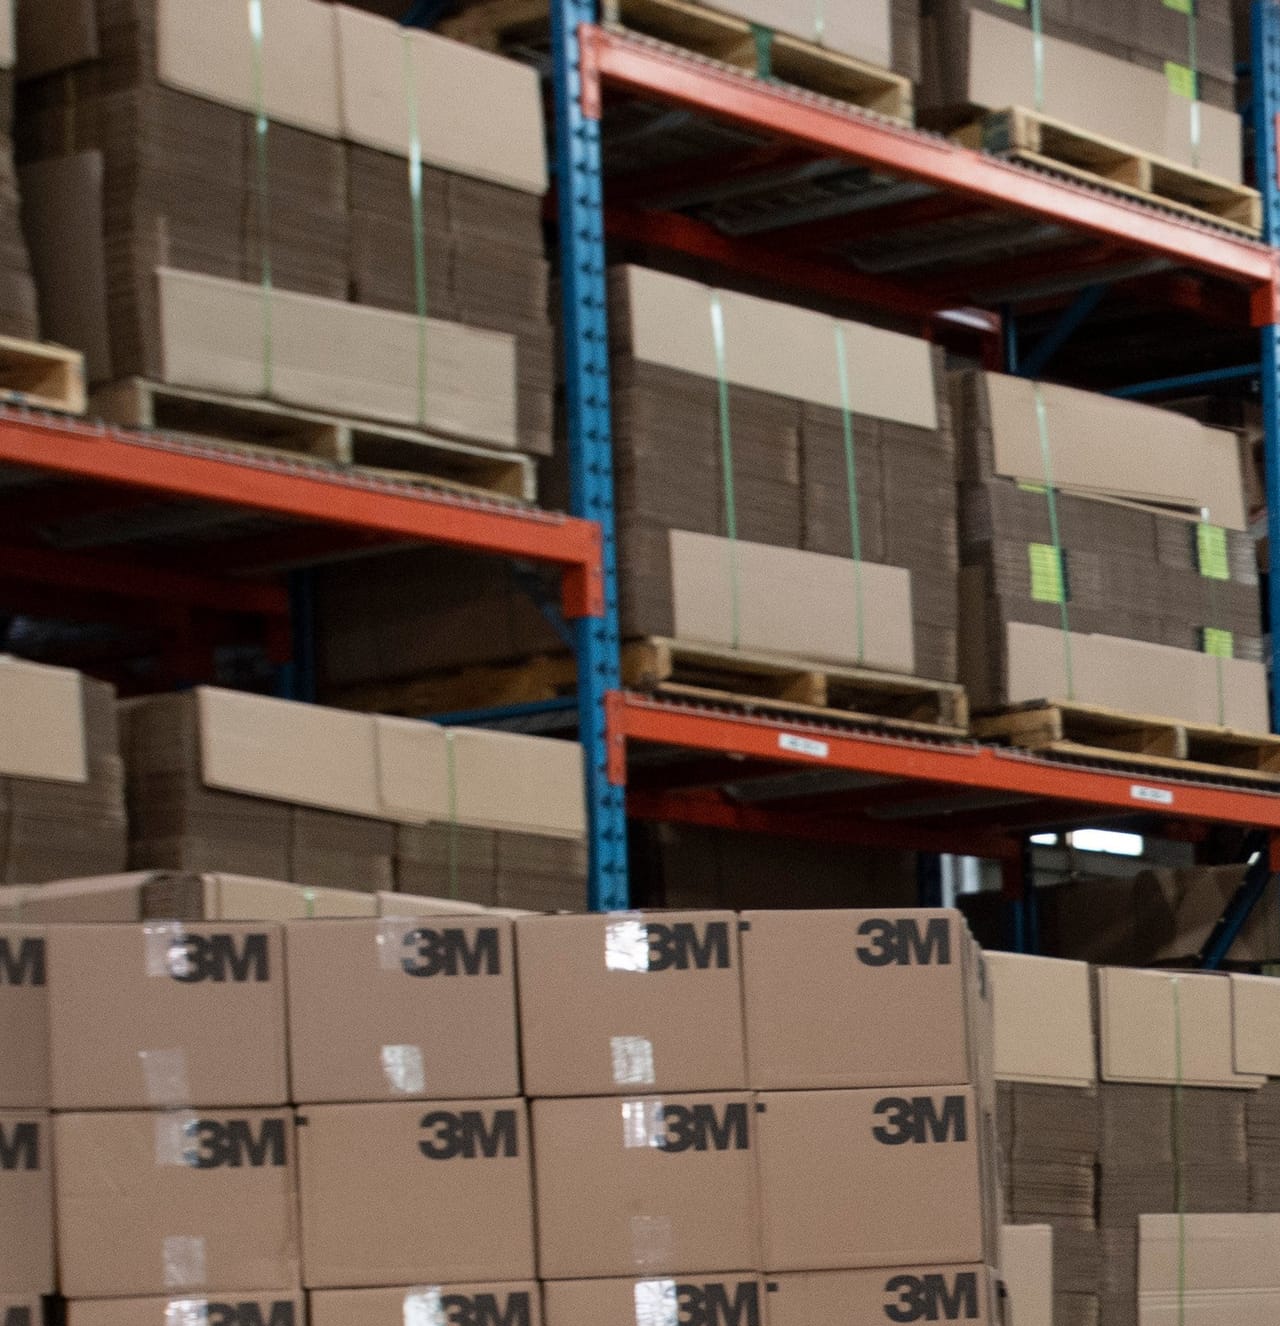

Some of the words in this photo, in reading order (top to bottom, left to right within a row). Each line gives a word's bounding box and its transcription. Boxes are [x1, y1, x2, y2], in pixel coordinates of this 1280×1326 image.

[0, 938, 46, 986] M
[170, 934, 269, 983] 3M
[405, 928, 500, 977] 3M
[646, 922, 730, 971] 3M
[856, 919, 951, 966] 3M
[184, 1119, 287, 1168] 3M
[419, 1110, 518, 1160] 3M
[656, 1103, 749, 1152] 3M
[873, 1096, 967, 1145] 3M
[0, 1123, 39, 1170] M
[884, 1272, 978, 1323] 3M
